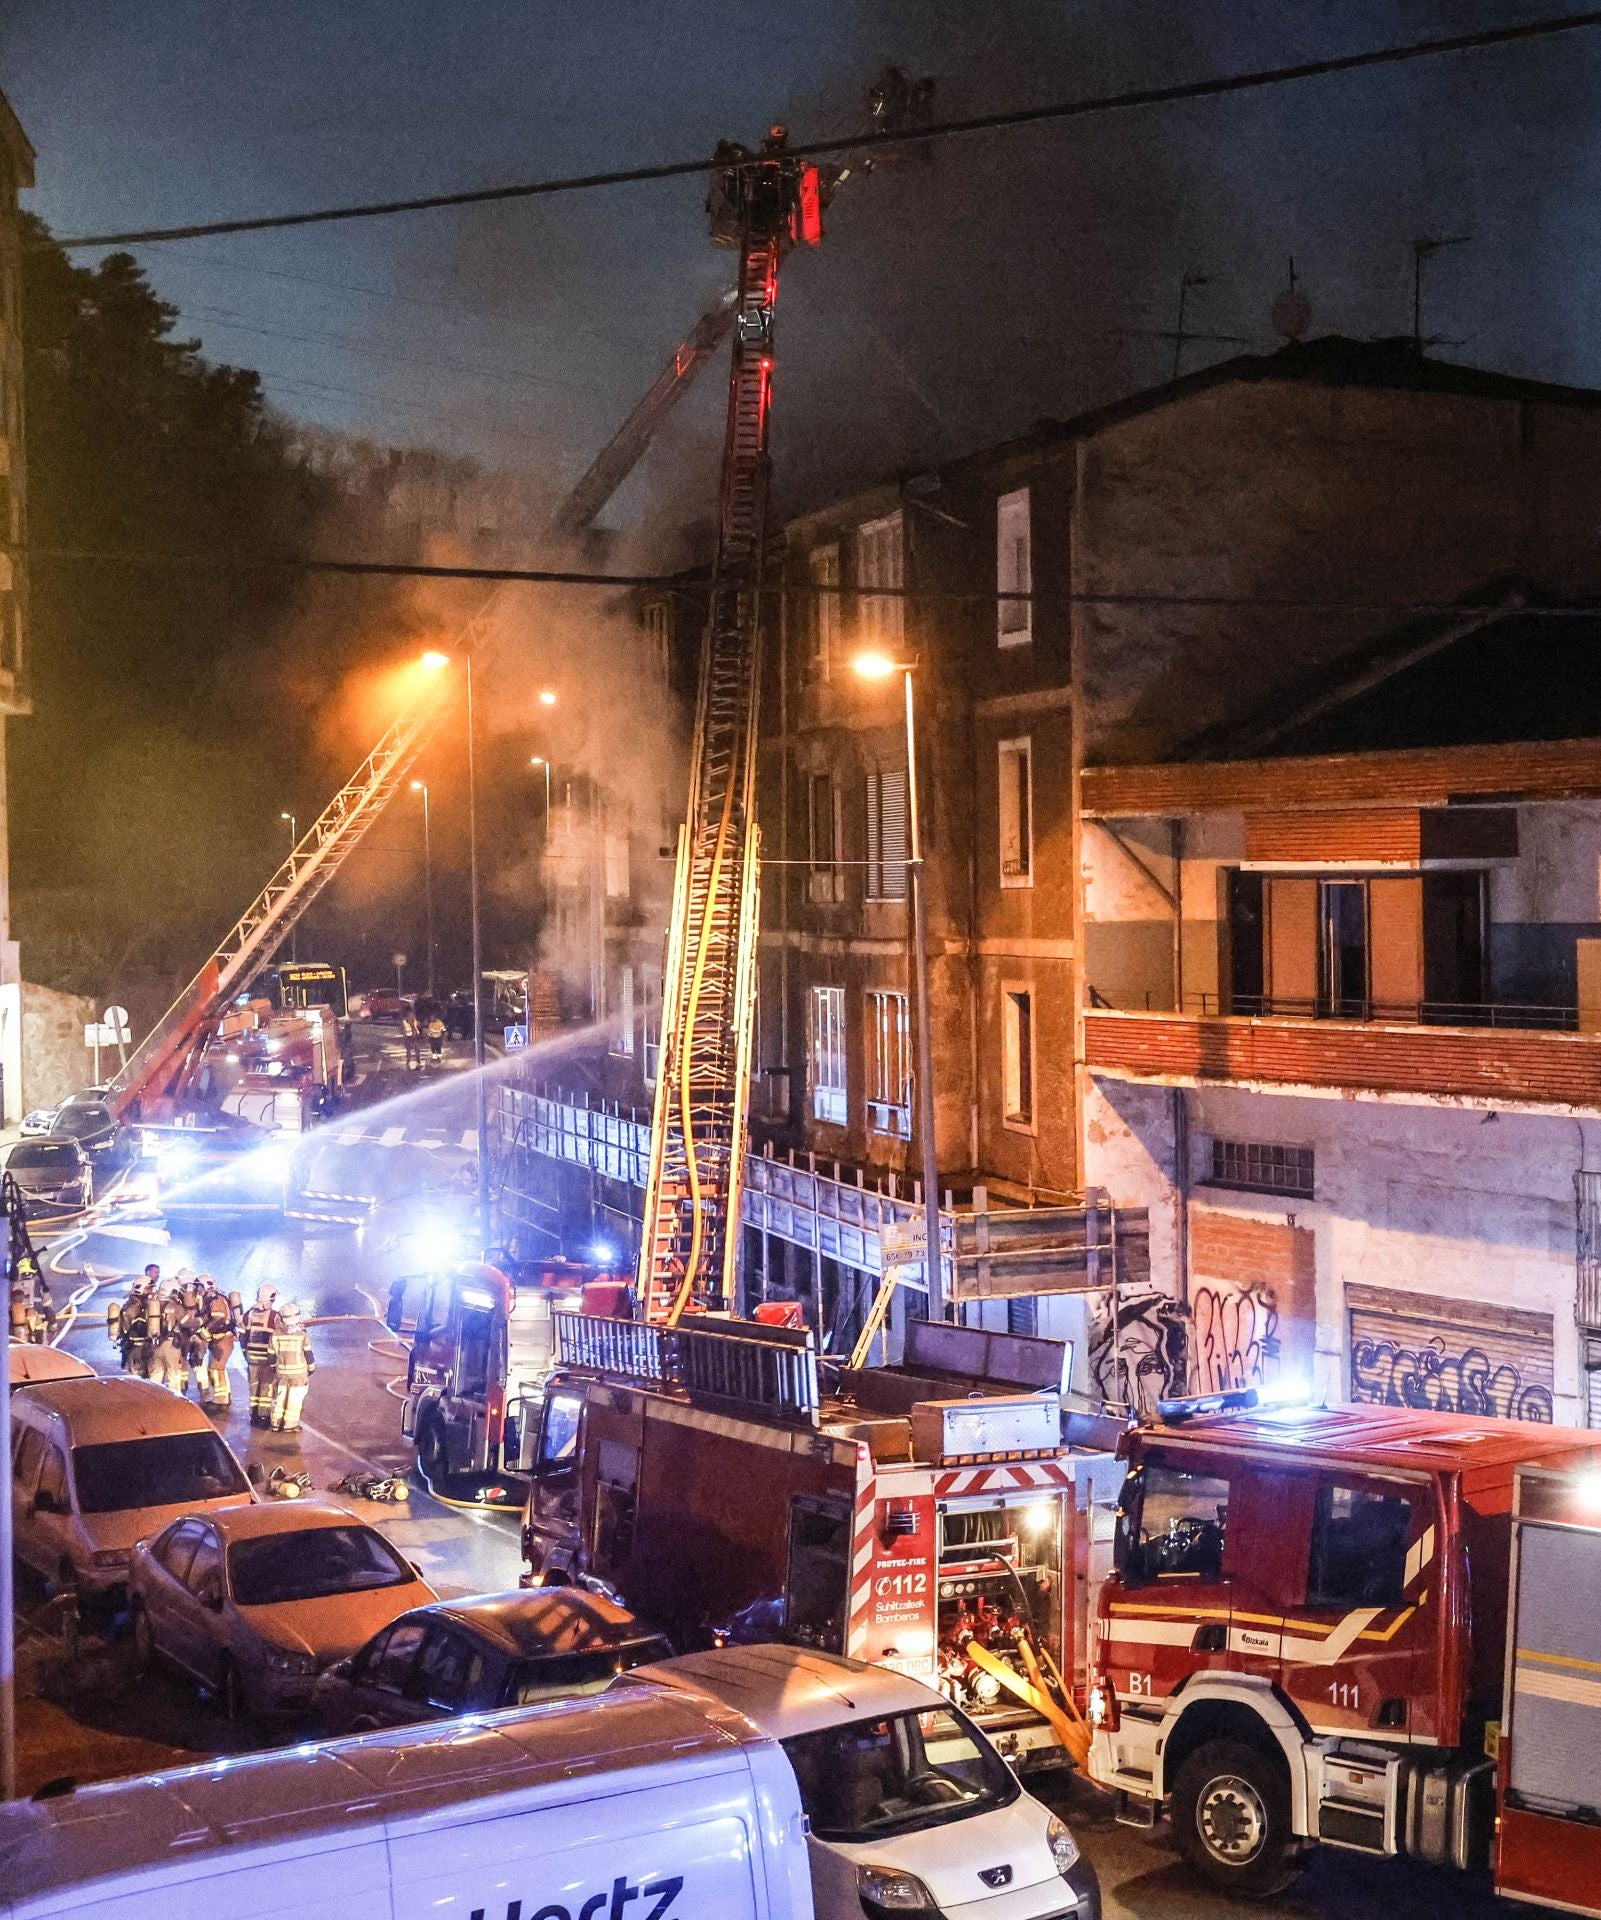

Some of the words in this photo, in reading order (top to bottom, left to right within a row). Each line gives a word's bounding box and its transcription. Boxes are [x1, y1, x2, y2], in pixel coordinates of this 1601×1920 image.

[892, 1573, 927, 1595] 112
[875, 1613, 920, 1624] Bomberos
[1129, 1672, 1152, 1696] B1
[1328, 1682, 1359, 1709] 111
